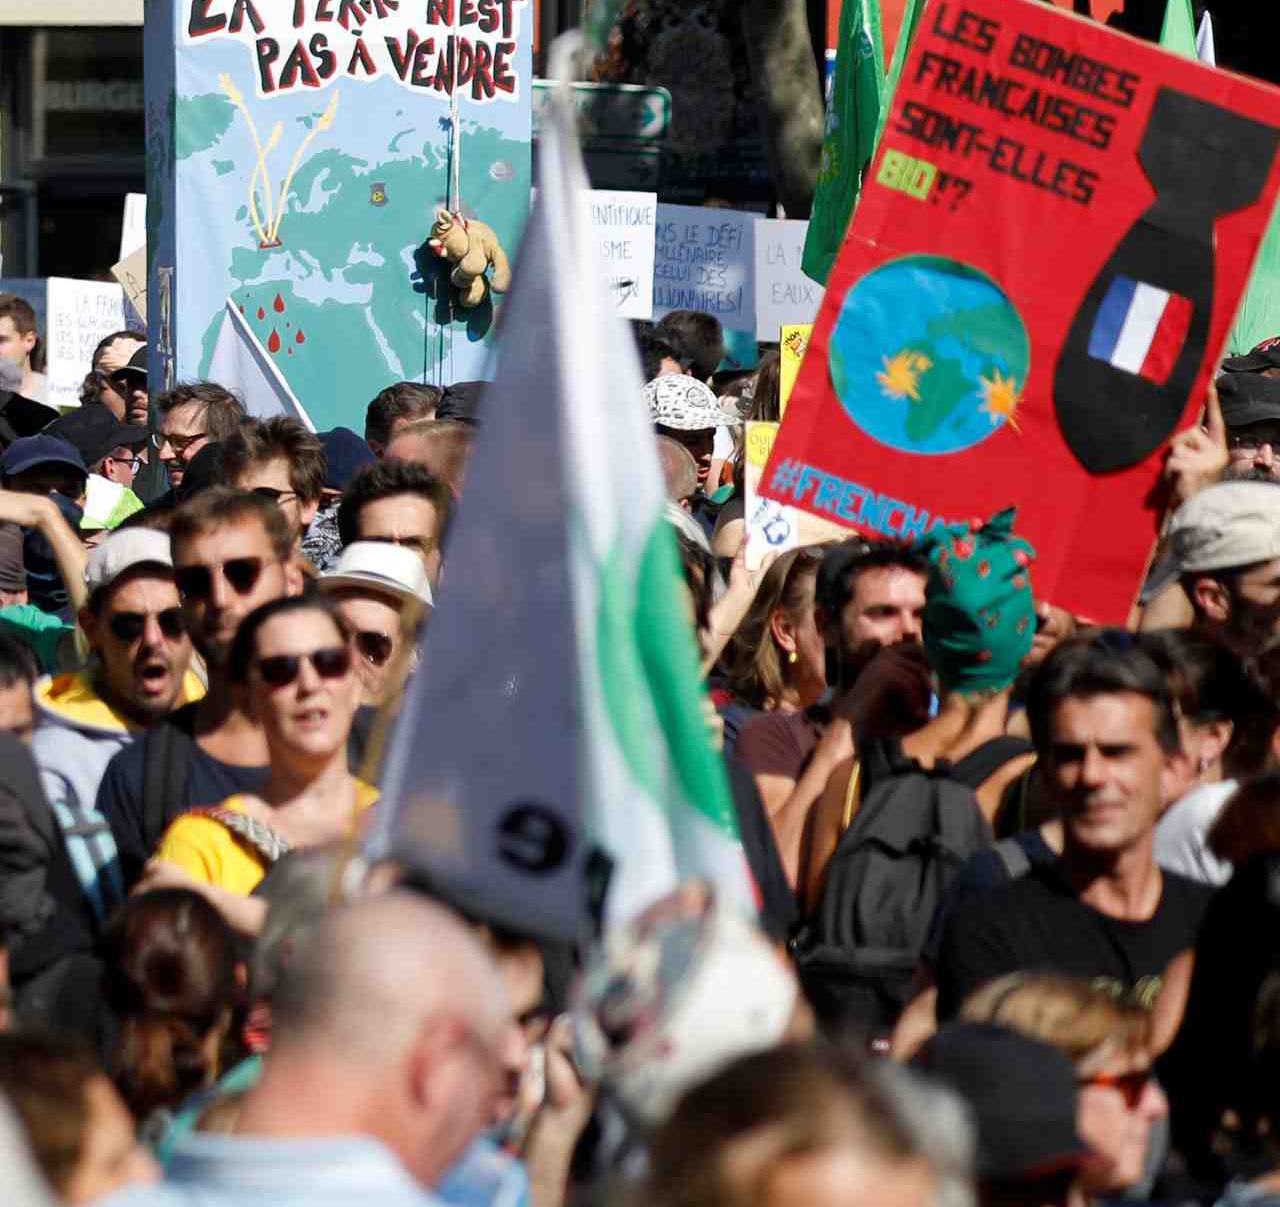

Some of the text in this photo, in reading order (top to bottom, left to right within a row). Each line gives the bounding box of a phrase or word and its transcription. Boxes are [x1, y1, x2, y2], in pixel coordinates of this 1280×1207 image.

[255, 28, 516, 101] PAS À VENDRE
[932, 2, 1140, 109] LES BOMBES
[896, 100, 1100, 206] SONT-ELLES
[770, 456, 971, 544] #FRENCH
